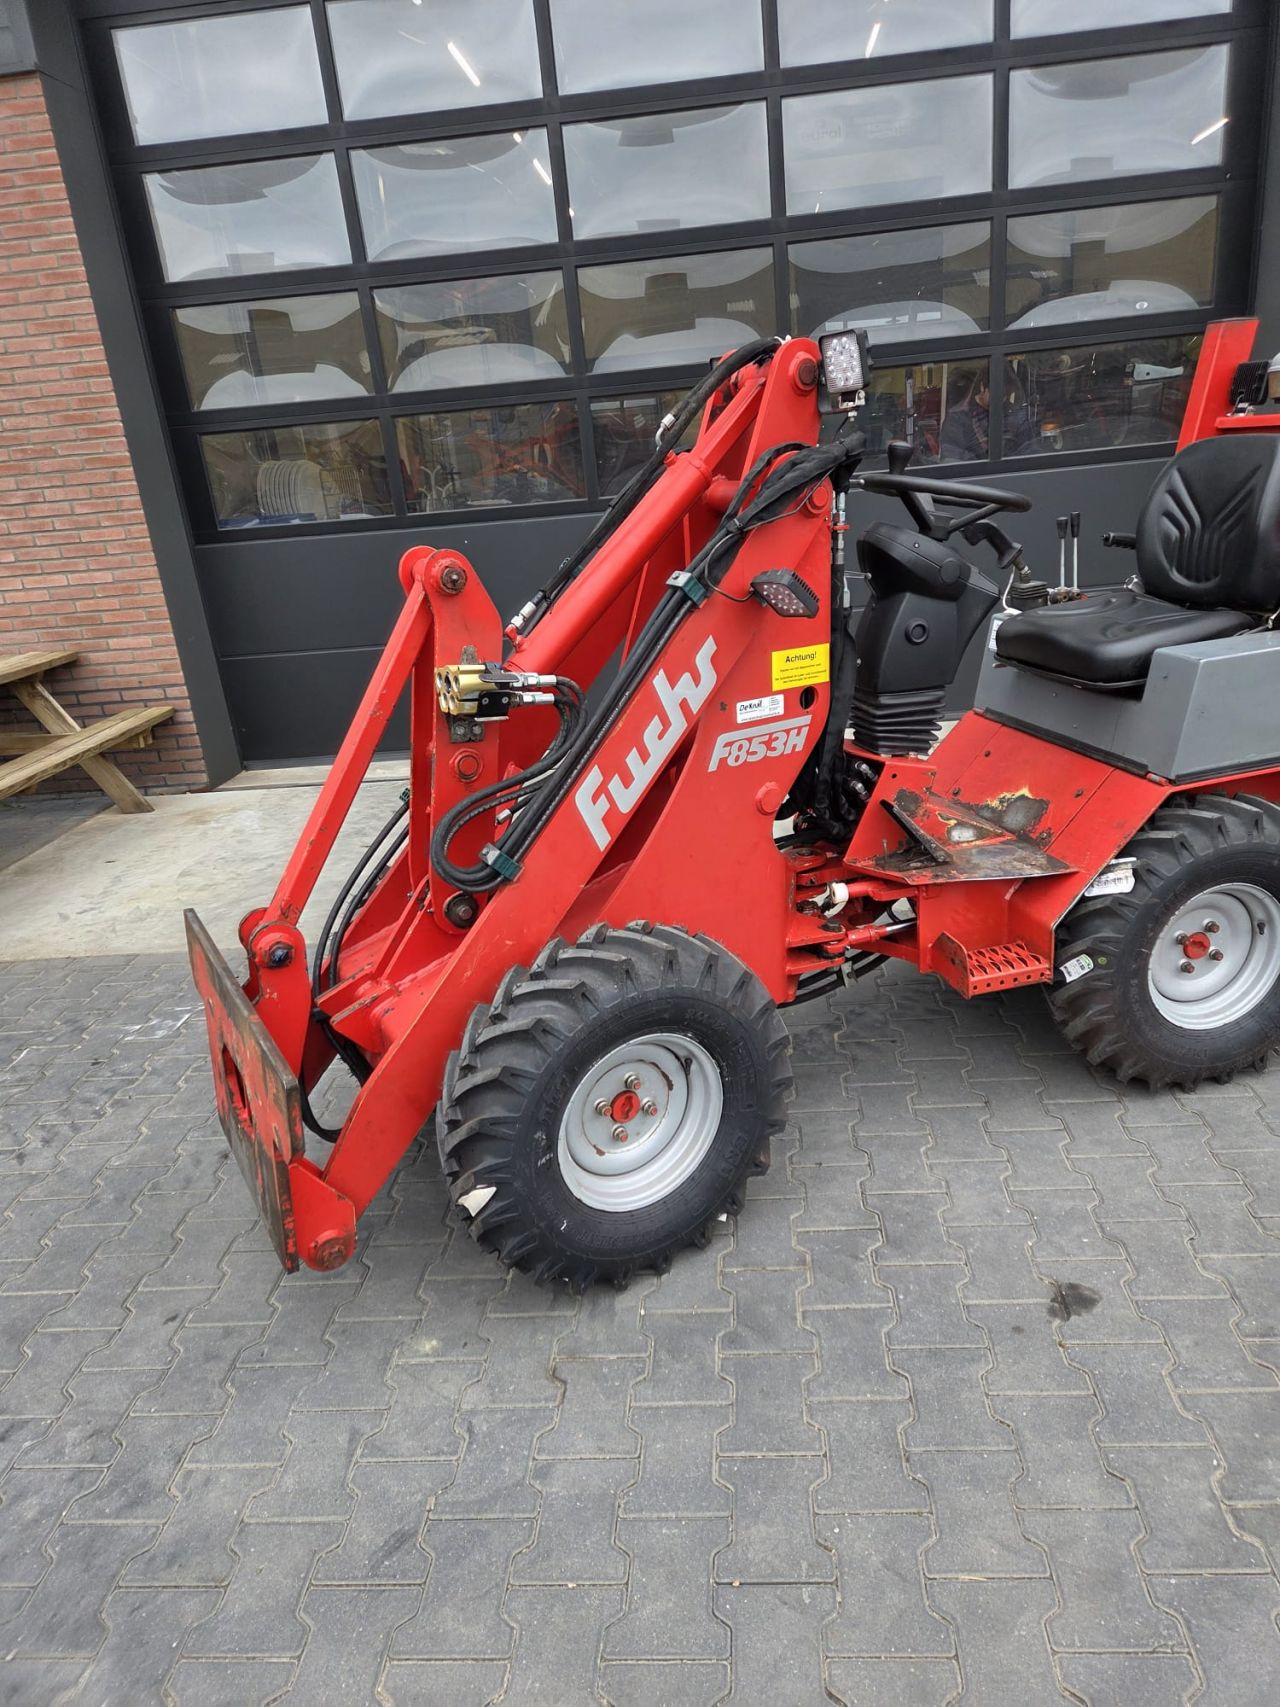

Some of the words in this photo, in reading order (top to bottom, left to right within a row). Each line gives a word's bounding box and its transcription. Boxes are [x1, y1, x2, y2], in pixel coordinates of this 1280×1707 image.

[785, 651, 817, 663] Achtung!
[575, 635, 718, 852] Fuchs
[707, 715, 812, 772] F853H
